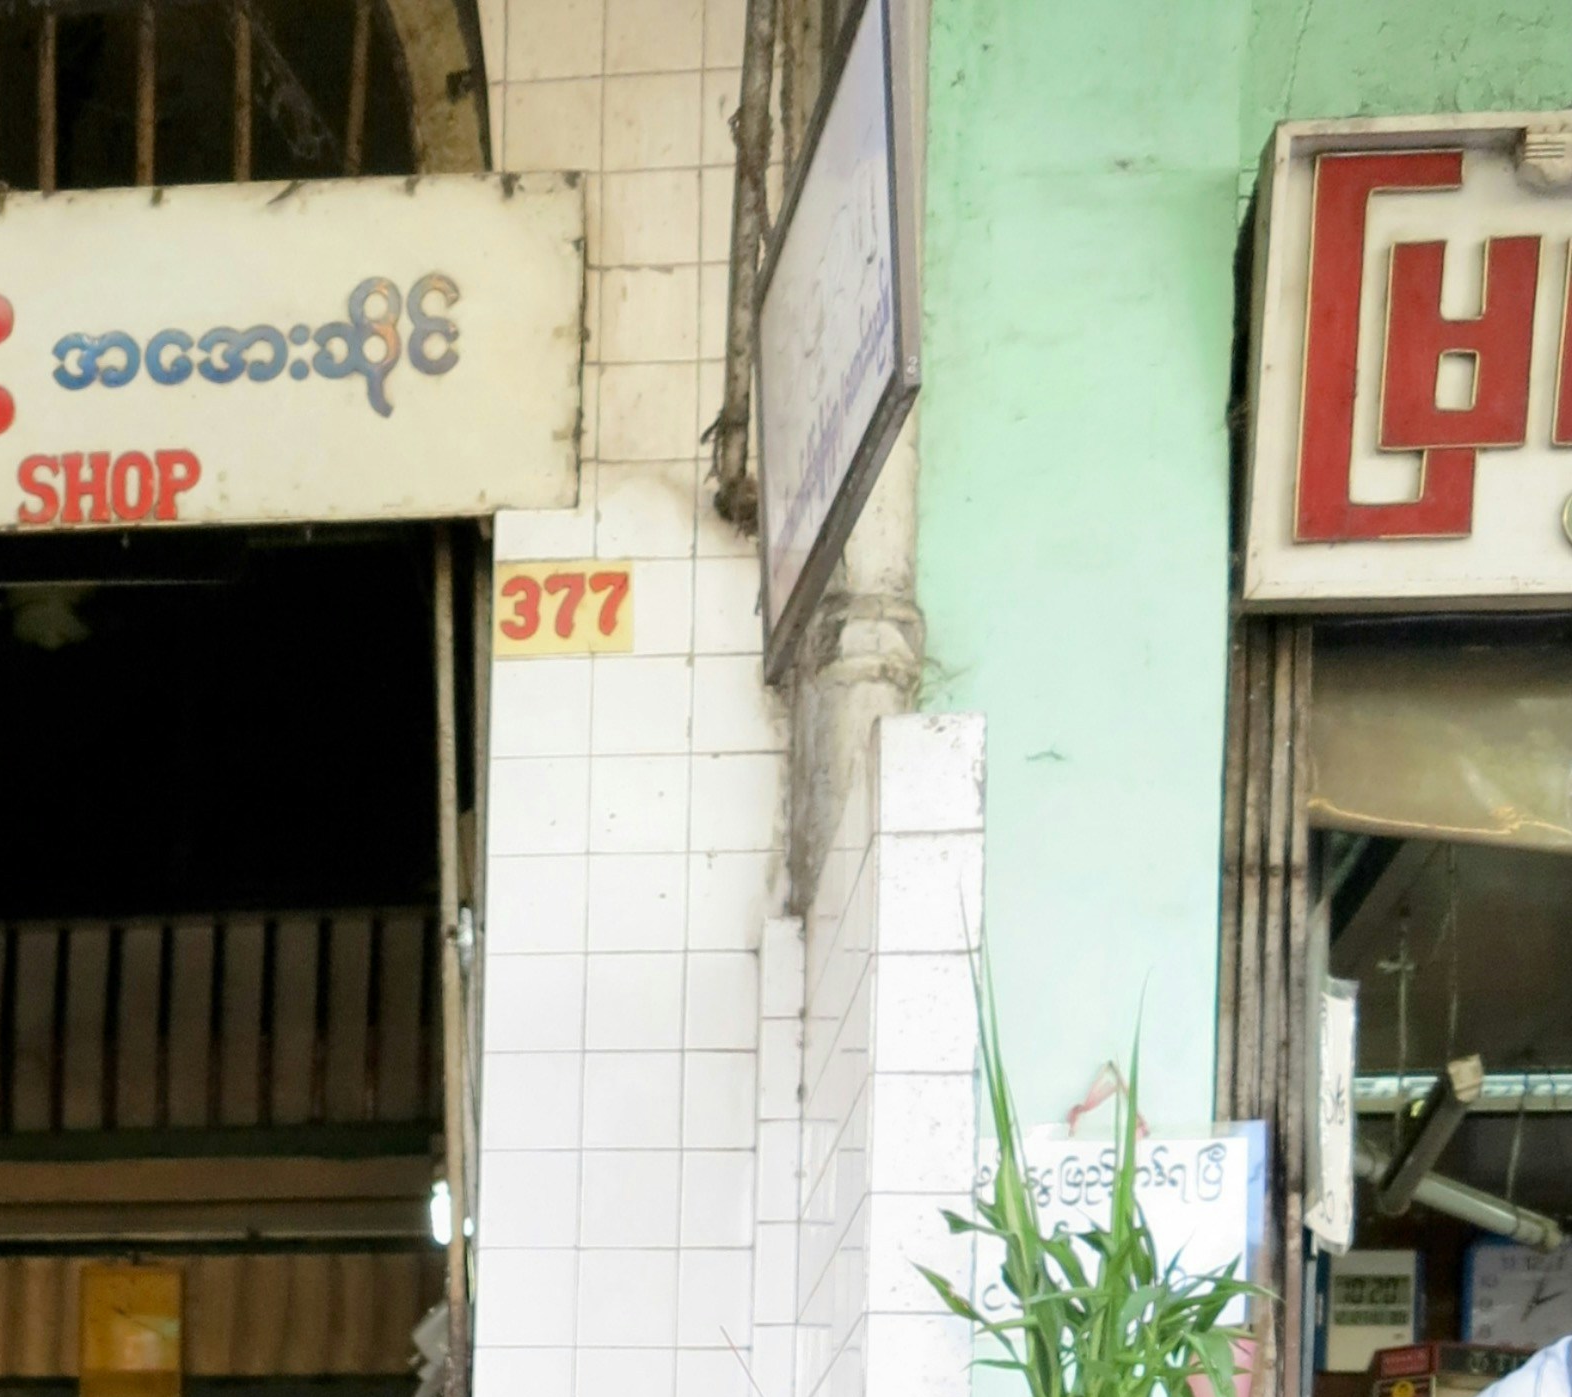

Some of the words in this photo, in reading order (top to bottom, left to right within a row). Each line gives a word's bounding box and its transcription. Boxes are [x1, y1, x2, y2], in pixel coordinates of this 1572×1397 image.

[52, 272, 460, 419] အအေးဆိုင်
[17, 449, 200, 525] SHOP
[500, 571, 629, 640] 377
